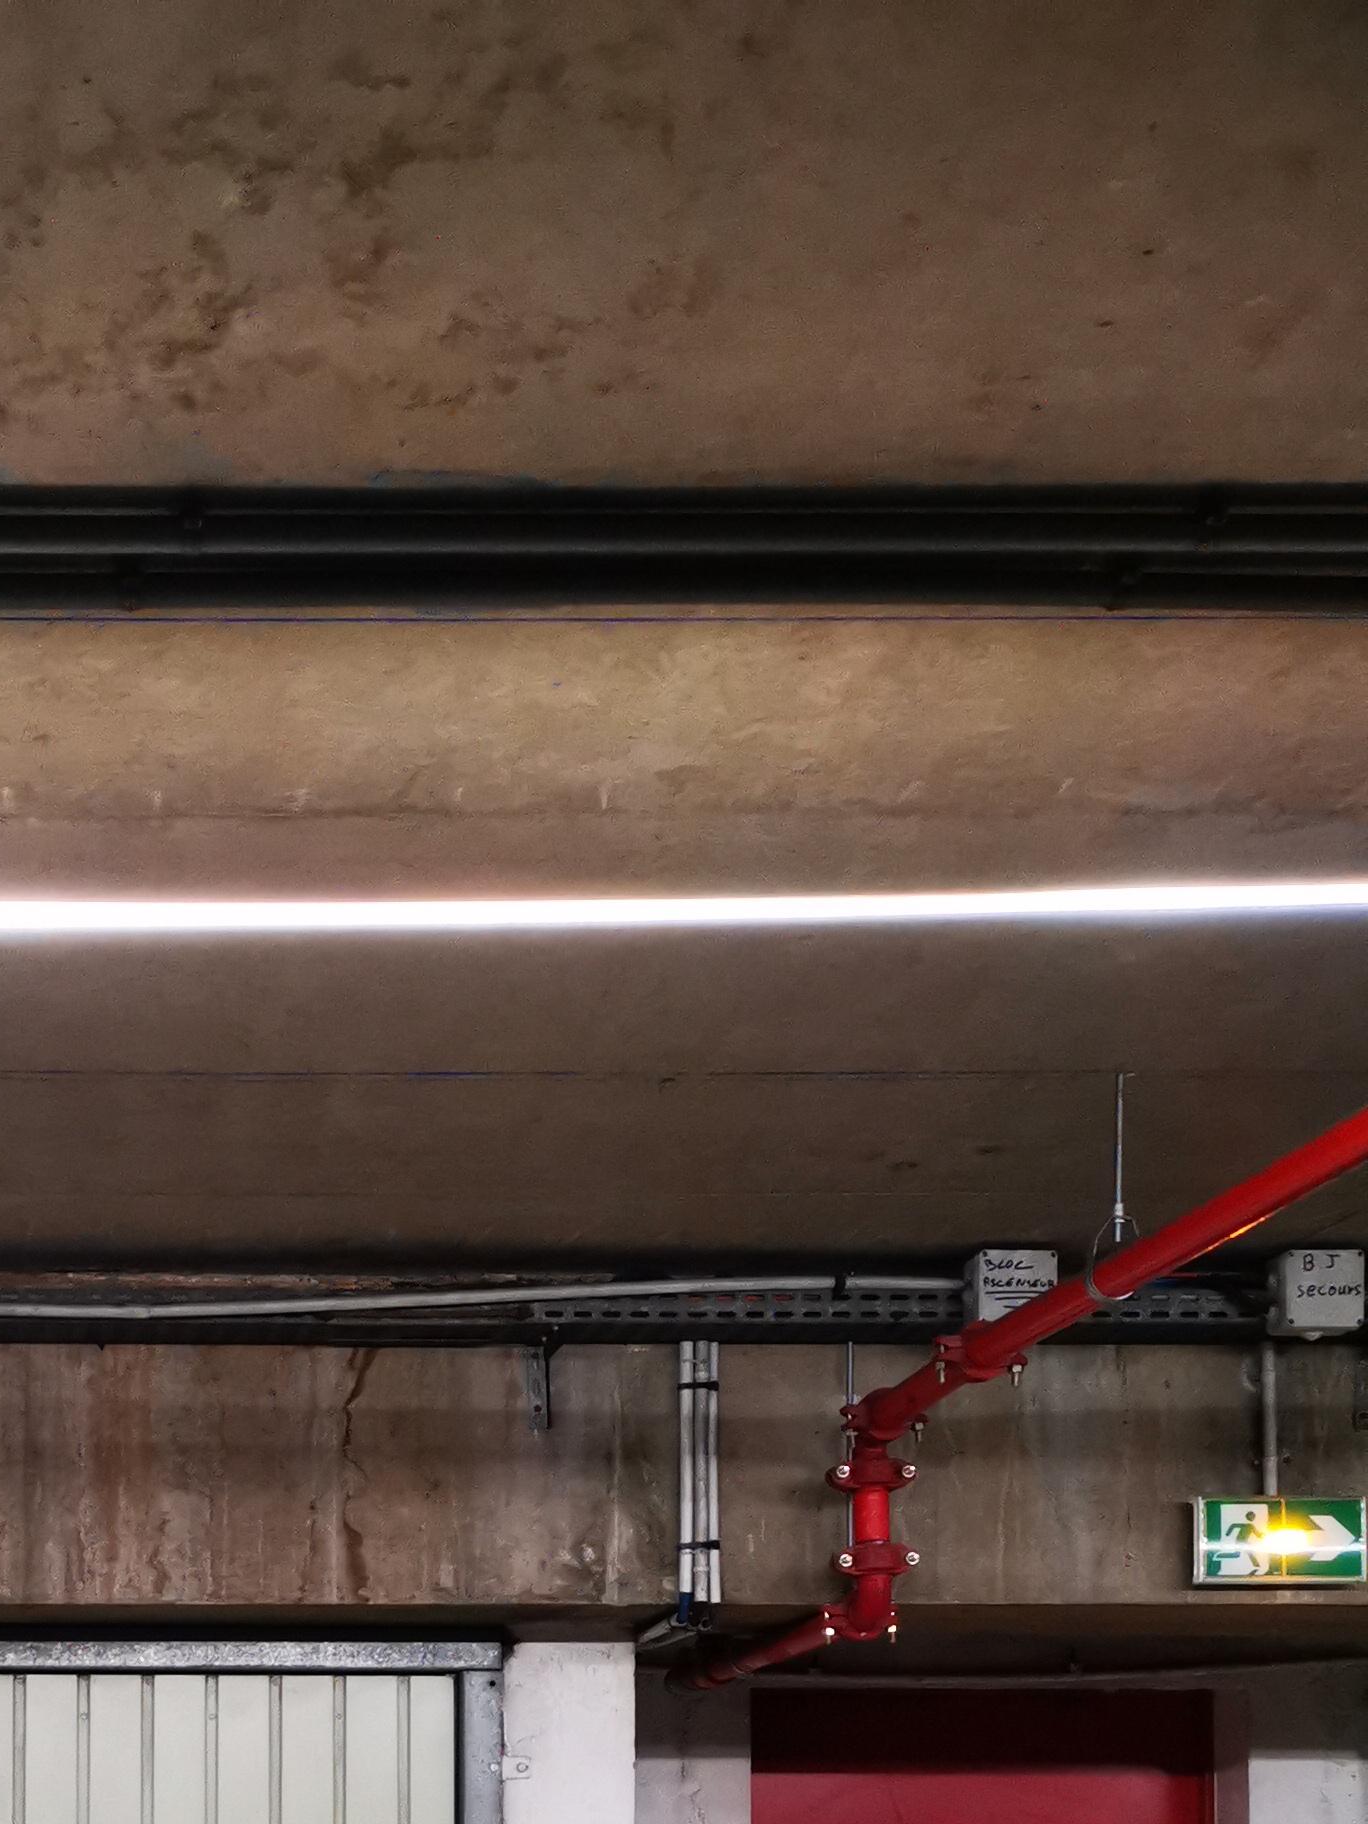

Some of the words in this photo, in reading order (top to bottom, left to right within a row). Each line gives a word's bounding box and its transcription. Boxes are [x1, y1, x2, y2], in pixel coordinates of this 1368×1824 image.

[983, 1258, 1034, 1271] BLOC
[983, 1276, 1055, 1288] ASCENSEUR
[1297, 1284, 1362, 1298] secours
